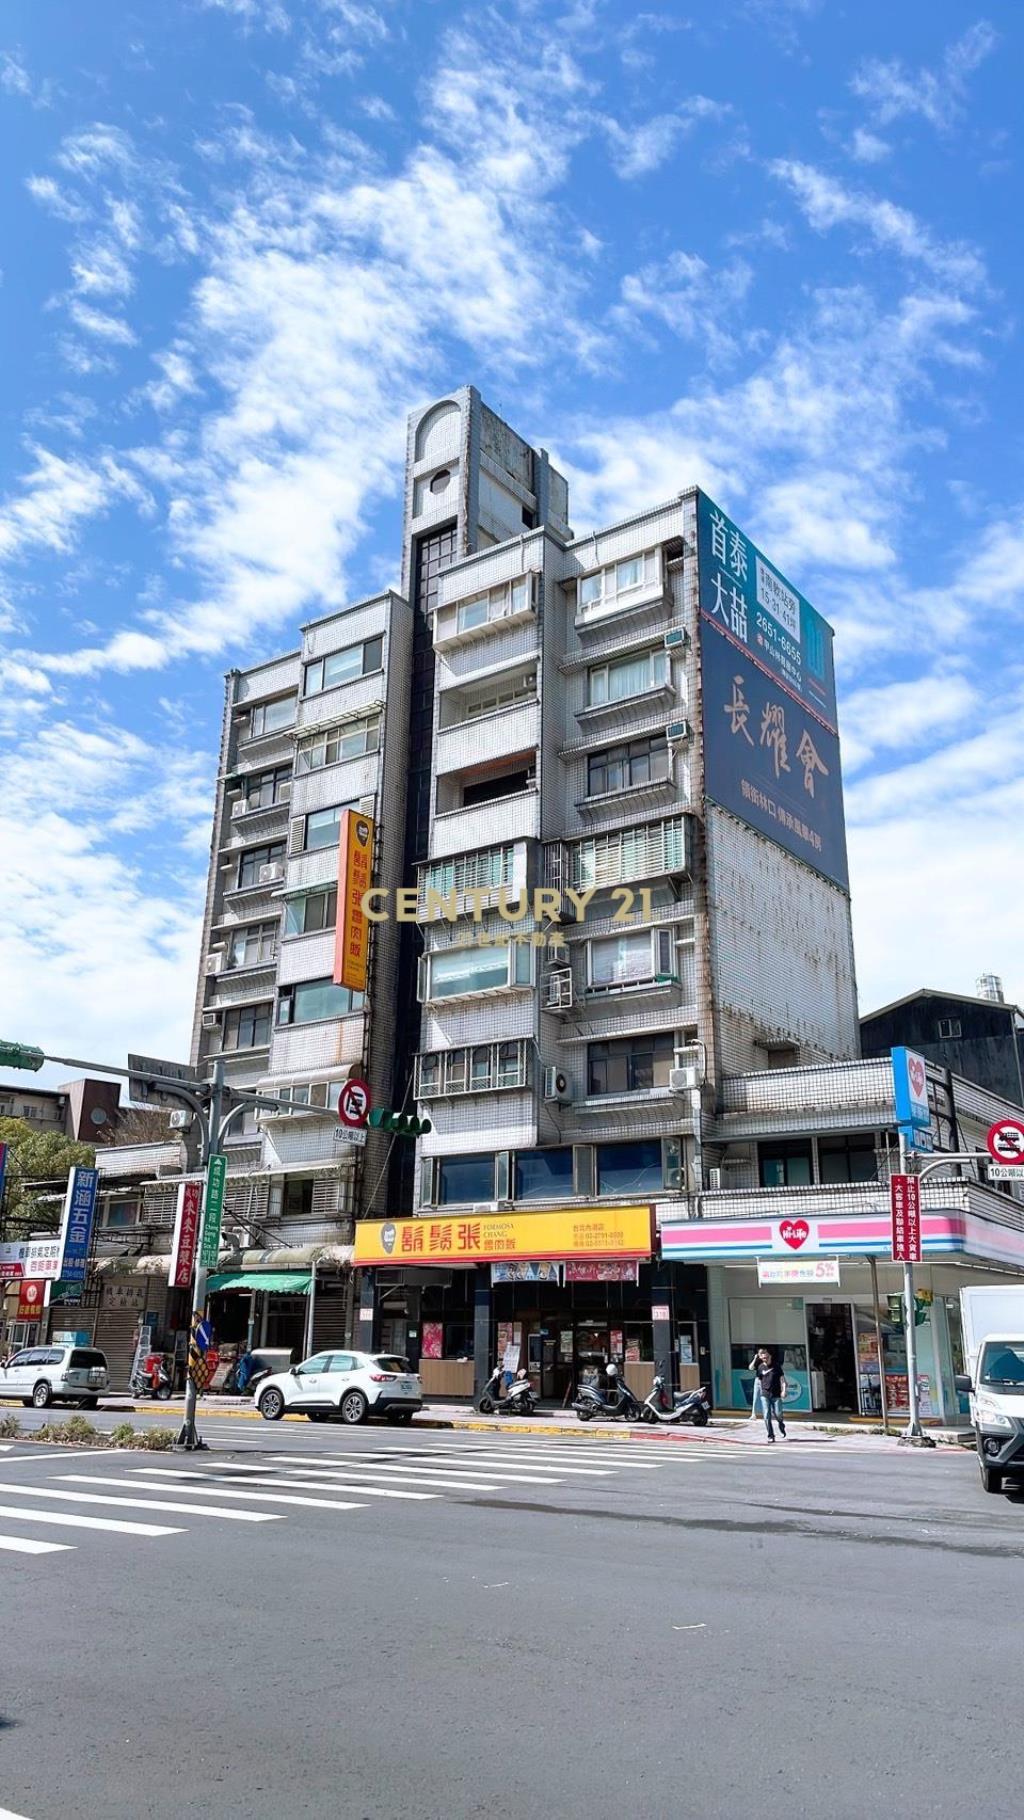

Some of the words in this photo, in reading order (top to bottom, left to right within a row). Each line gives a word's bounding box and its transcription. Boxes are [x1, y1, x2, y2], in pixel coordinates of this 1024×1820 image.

[710, 509, 747, 581] 首泰
[711, 572, 747, 643] 大喆
[401, 1223, 480, 1252] 鬍鬚張
[782, 1226, 807, 1239] Hi-Life
